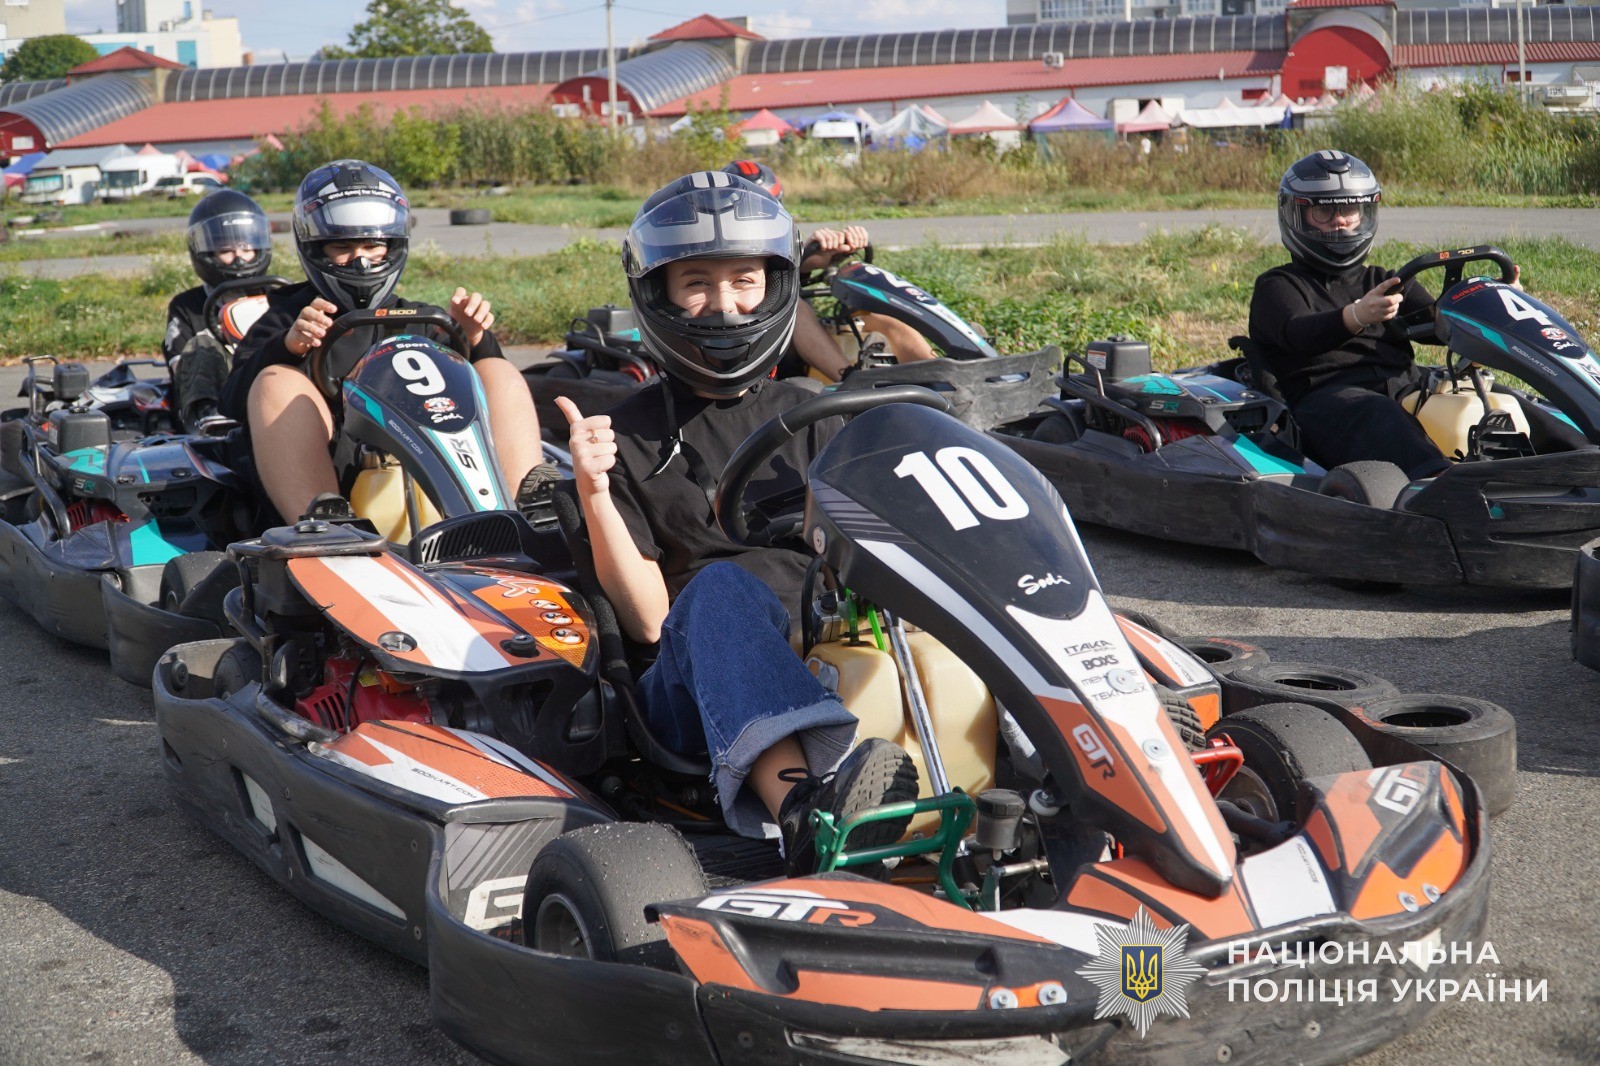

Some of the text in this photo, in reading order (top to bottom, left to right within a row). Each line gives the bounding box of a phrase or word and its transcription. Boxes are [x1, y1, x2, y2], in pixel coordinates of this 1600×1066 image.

[1496, 288, 1554, 326] 4
[391, 349, 447, 396] 9
[893, 446, 1030, 532] 10
[1017, 573, 1071, 595] Sodi
[1063, 639, 1115, 655] ITAKA
[1072, 722, 1116, 781] GTR
